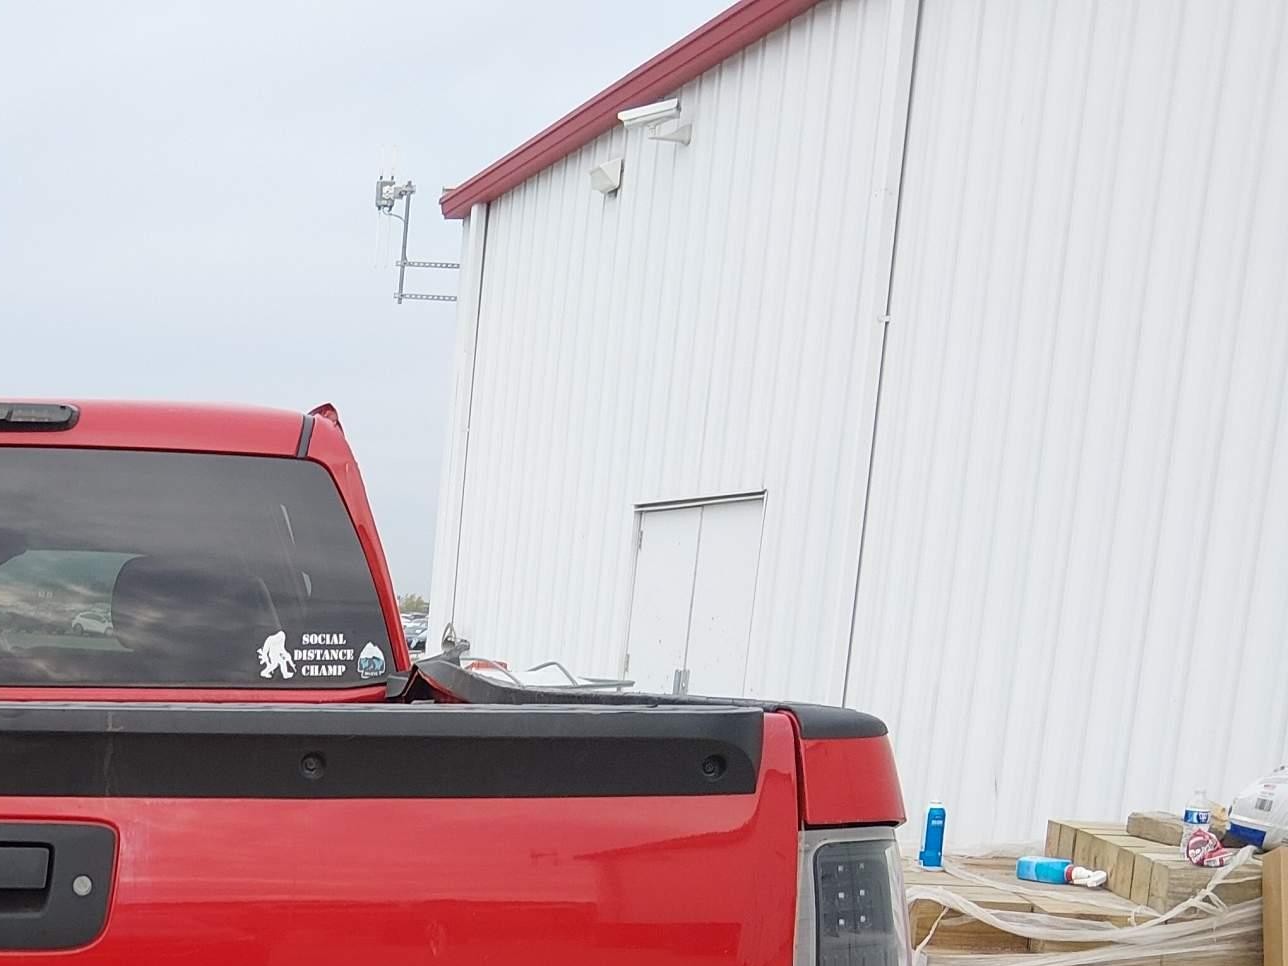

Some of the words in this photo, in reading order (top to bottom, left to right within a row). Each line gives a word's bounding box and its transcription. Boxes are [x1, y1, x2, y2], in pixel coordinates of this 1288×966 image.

[302, 633, 346, 645] SOCIAL
[293, 649, 354, 661] DISTANCE
[301, 665, 346, 676] CHAMP
